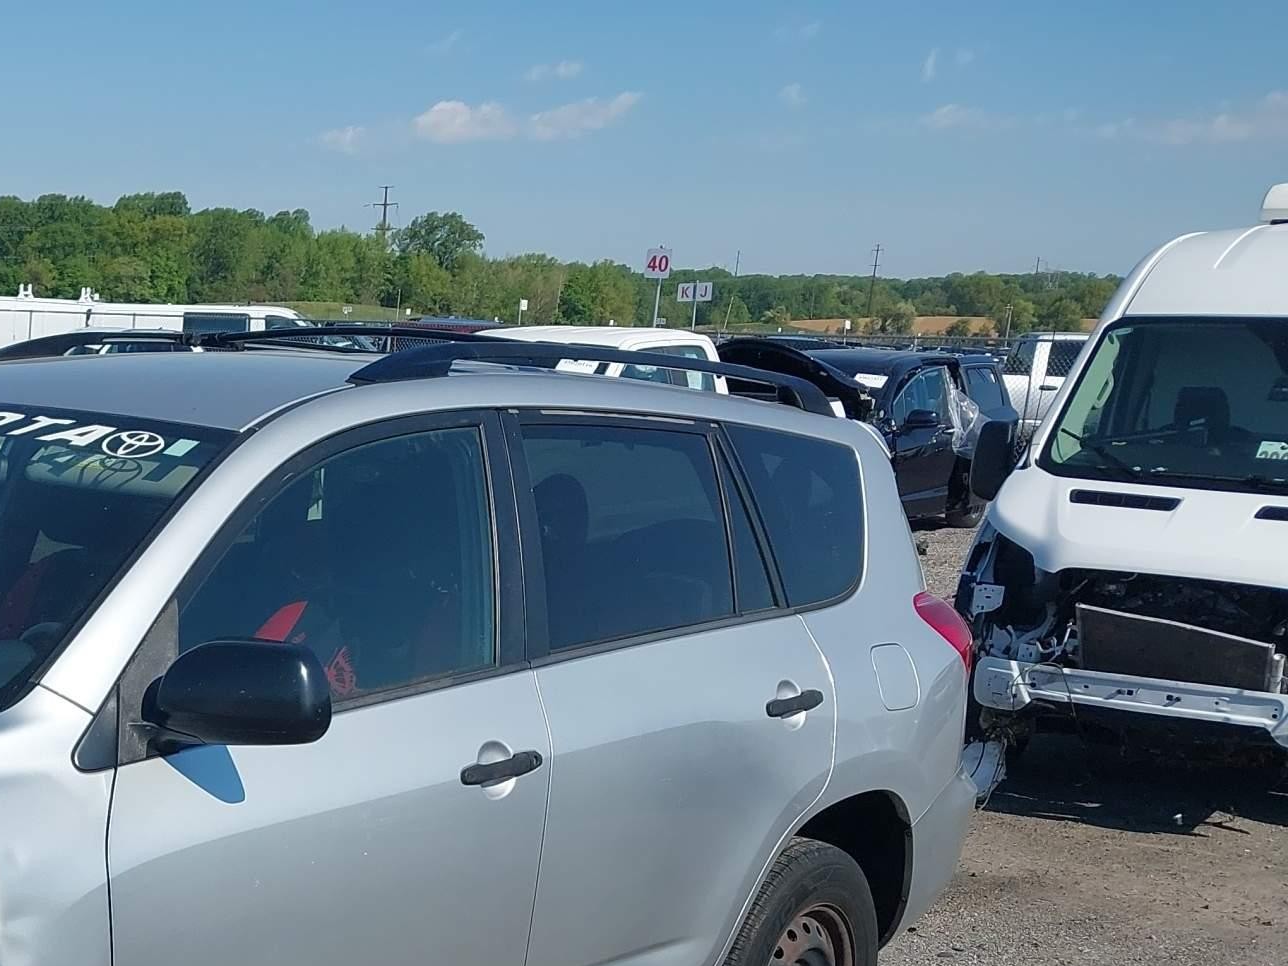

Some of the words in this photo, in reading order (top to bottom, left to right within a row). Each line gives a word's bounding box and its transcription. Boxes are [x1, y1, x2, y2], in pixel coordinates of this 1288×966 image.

[647, 255, 669, 272] 40
[681, 286, 690, 298] K
[700, 285, 708, 298] J
